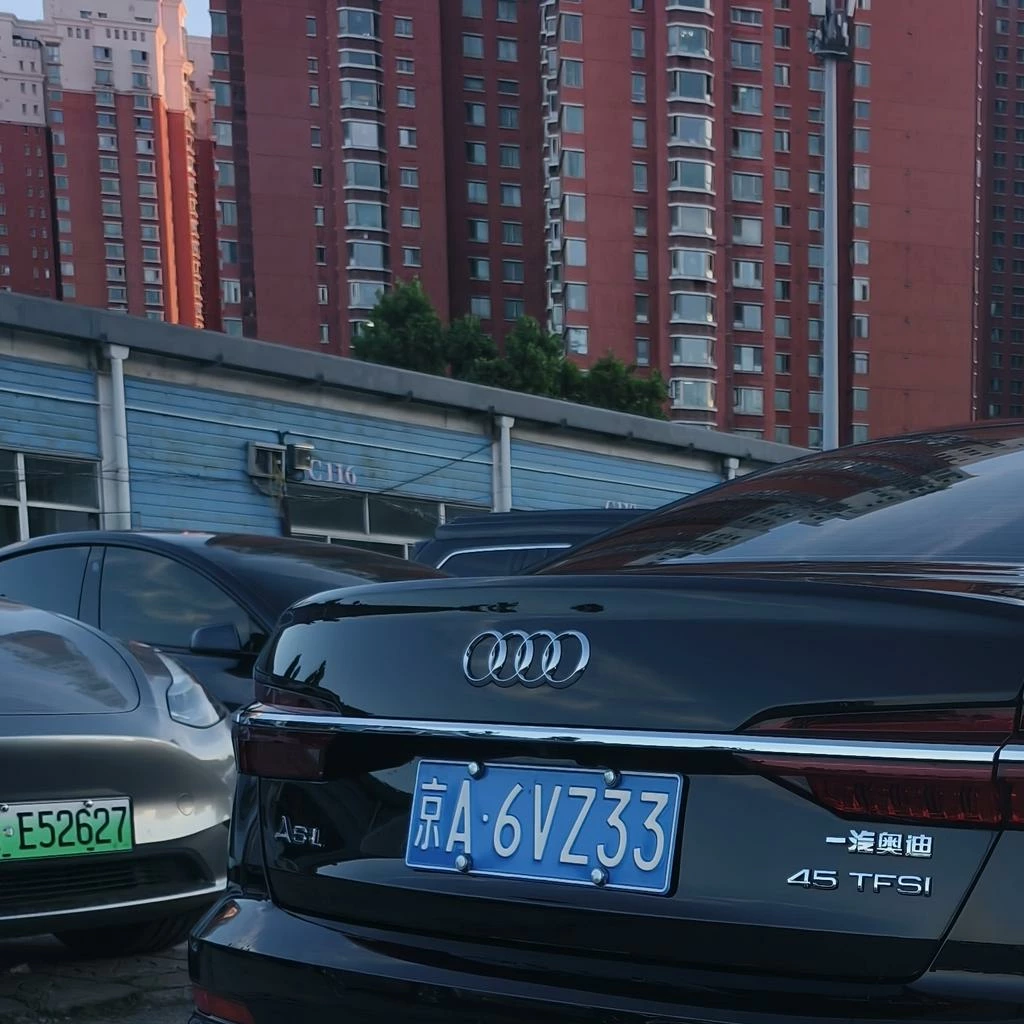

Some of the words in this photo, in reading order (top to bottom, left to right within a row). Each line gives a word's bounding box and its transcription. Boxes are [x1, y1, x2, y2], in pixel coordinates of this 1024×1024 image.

[16, 806, 127, 850] E52627
[825, 829, 933, 858] 一汽奥迪
[787, 868, 838, 889] 45
[849, 872, 932, 897] TFSI
